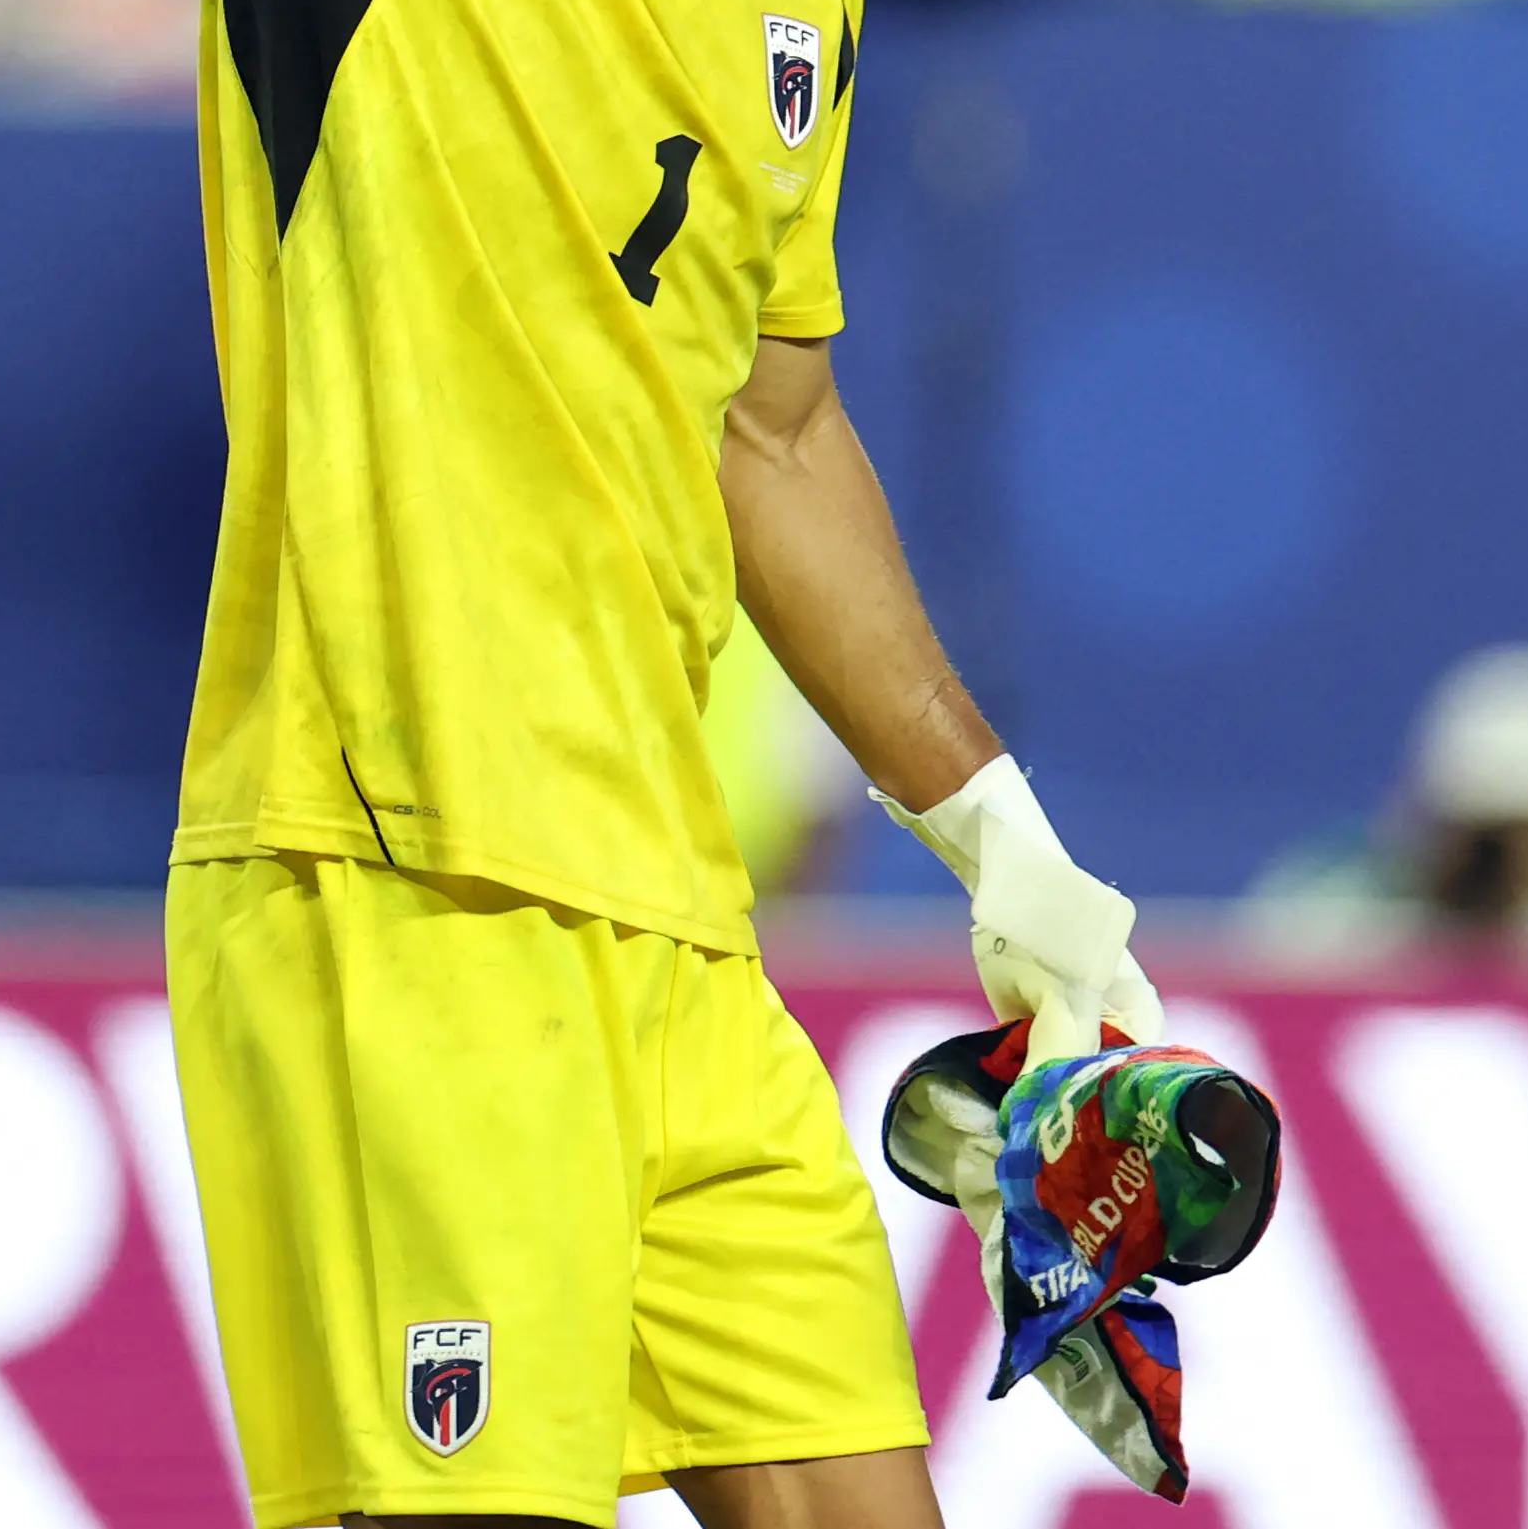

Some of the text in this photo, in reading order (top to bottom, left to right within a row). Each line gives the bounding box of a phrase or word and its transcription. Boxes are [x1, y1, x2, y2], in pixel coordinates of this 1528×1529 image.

[769, 21, 815, 47] FCF
[608, 133, 704, 308] 1
[1029, 1260, 1089, 1309] FIFA
[1071, 1197, 1123, 1268] RLD
[1112, 1146, 1148, 1204] CUP
[413, 1327, 482, 1350] FCF
